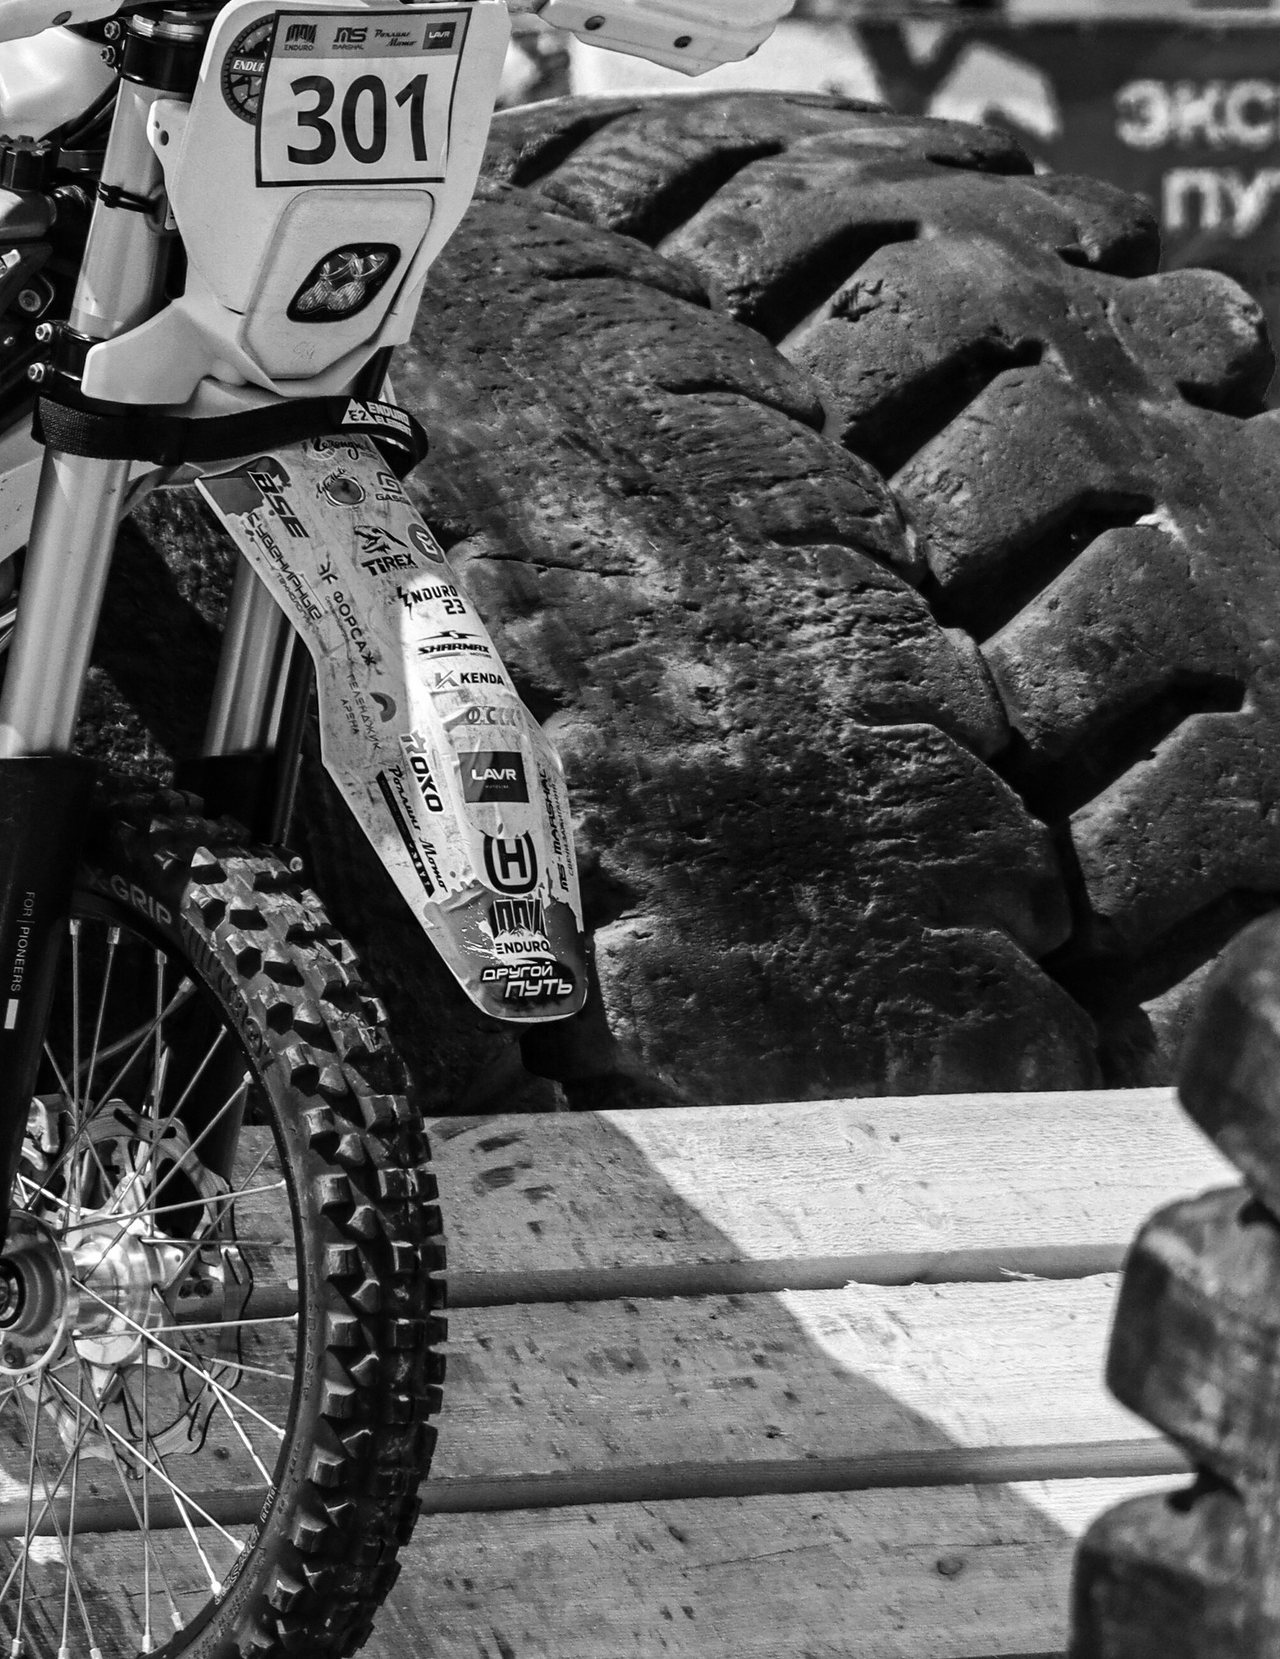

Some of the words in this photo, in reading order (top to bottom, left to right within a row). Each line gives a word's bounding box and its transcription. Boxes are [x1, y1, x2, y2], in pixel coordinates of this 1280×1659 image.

[428, 30, 451, 39] LAVR
[283, 43, 315, 51] ENDURO
[287, 73, 428, 166] 301
[366, 401, 410, 427] ENDURO
[246, 511, 322, 621] СУВЕНИРНЫЕ
[441, 598, 467, 615] 23
[333, 590, 377, 667] ФОРСАЖ
[417, 642, 489, 655] SHARMAX
[460, 672, 505, 686] KENDA
[340, 697, 360, 736] АРЕНА
[346, 673, 382, 751] ГЕЛЕНДЖИК
[471, 768, 516, 781] LAVR
[22, 891, 35, 923] FOR
[495, 940, 549, 955] ENDURO
[10, 926, 30, 992] PIONEERS
[482, 961, 553, 981] ДРУГОЙ
[504, 978, 573, 998] ПУТЬ
